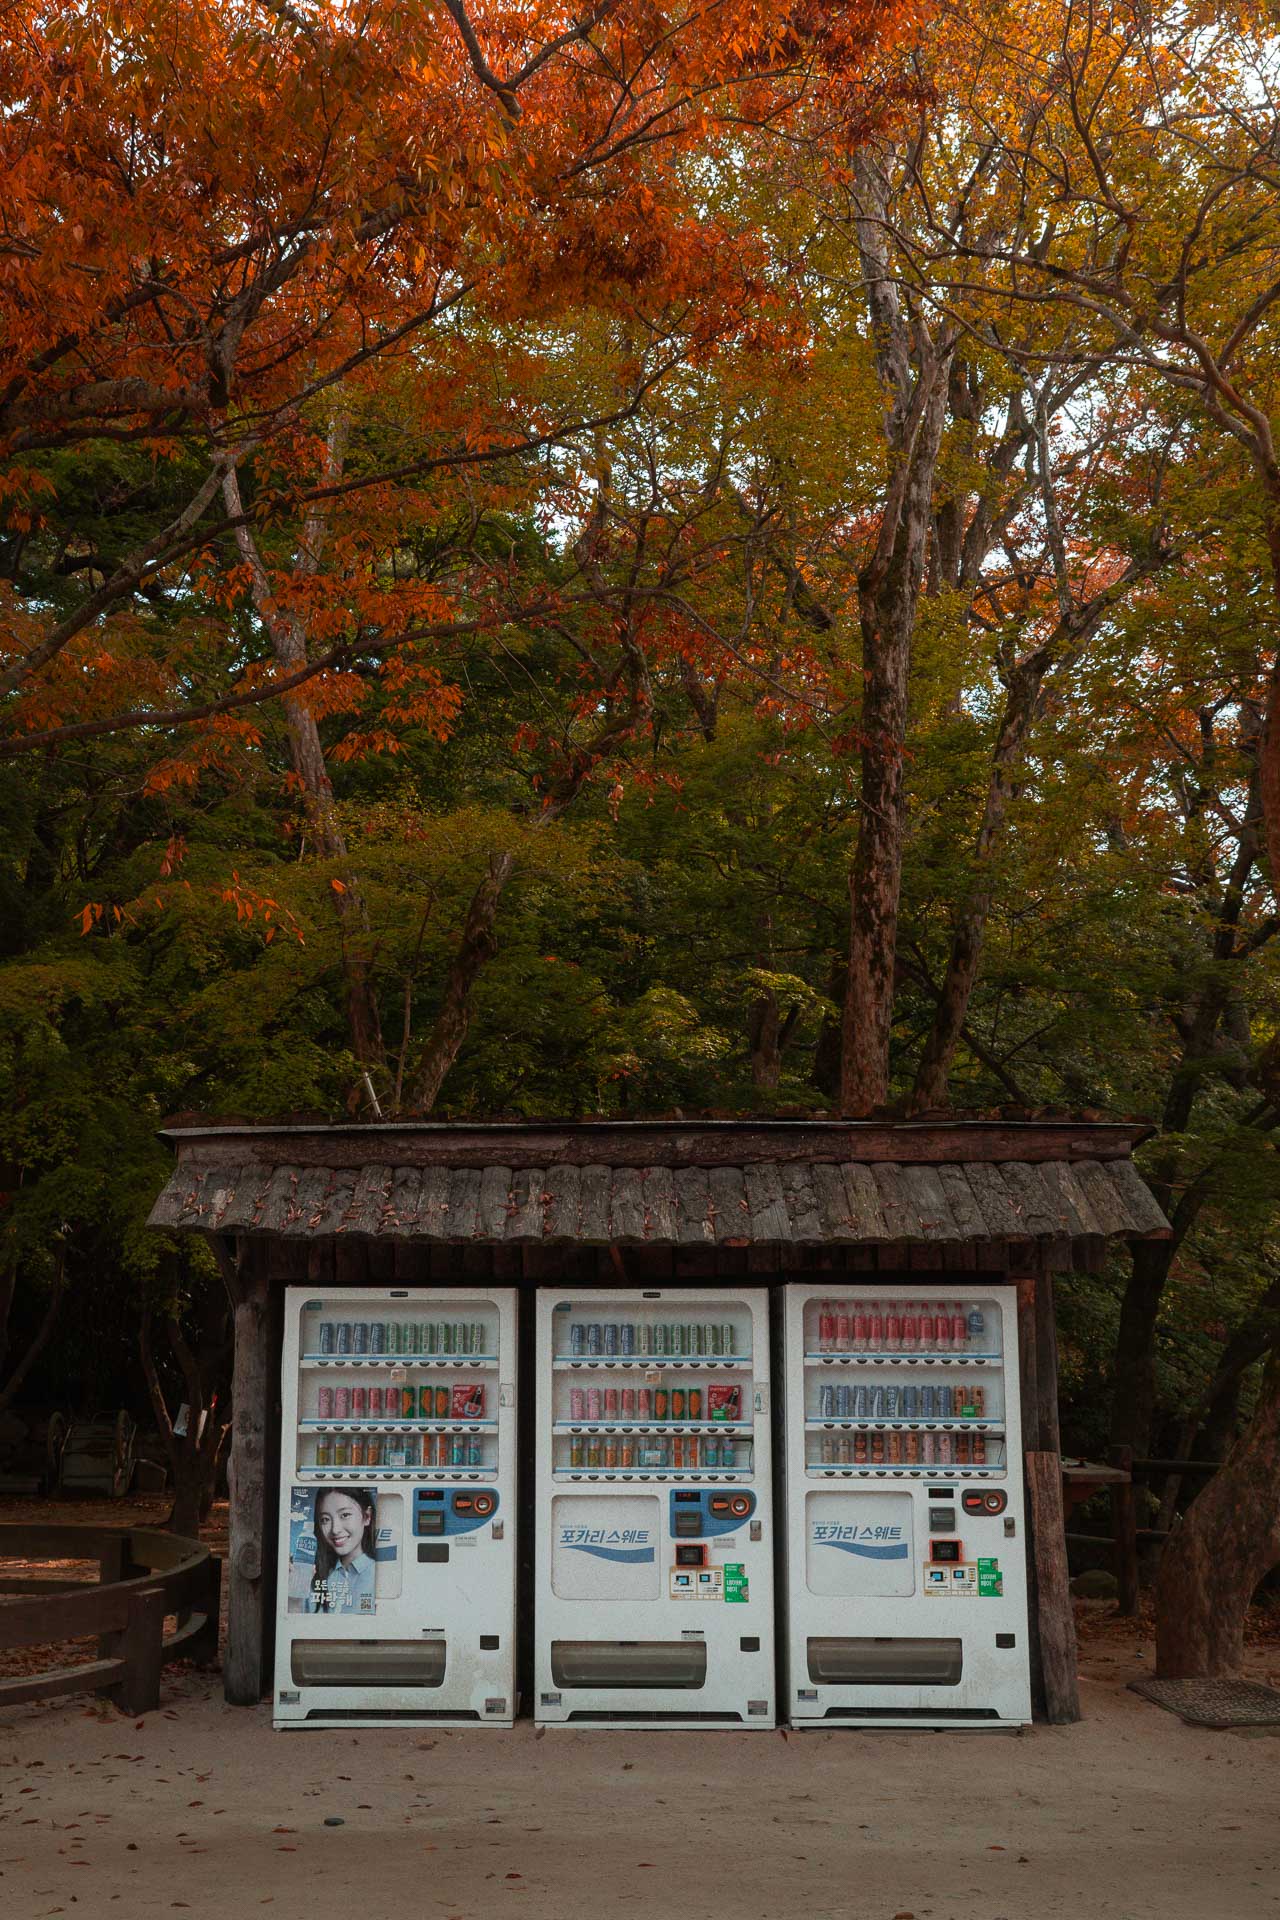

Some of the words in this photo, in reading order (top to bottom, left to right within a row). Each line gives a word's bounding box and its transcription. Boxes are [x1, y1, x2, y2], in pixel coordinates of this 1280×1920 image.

[560, 1529, 605, 1543] 포카리
[606, 1529, 649, 1543] 스웨트
[813, 1526, 858, 1540] 포카리
[859, 1526, 902, 1540] 스웨트
[310, 1591, 353, 1608] 파랑해
